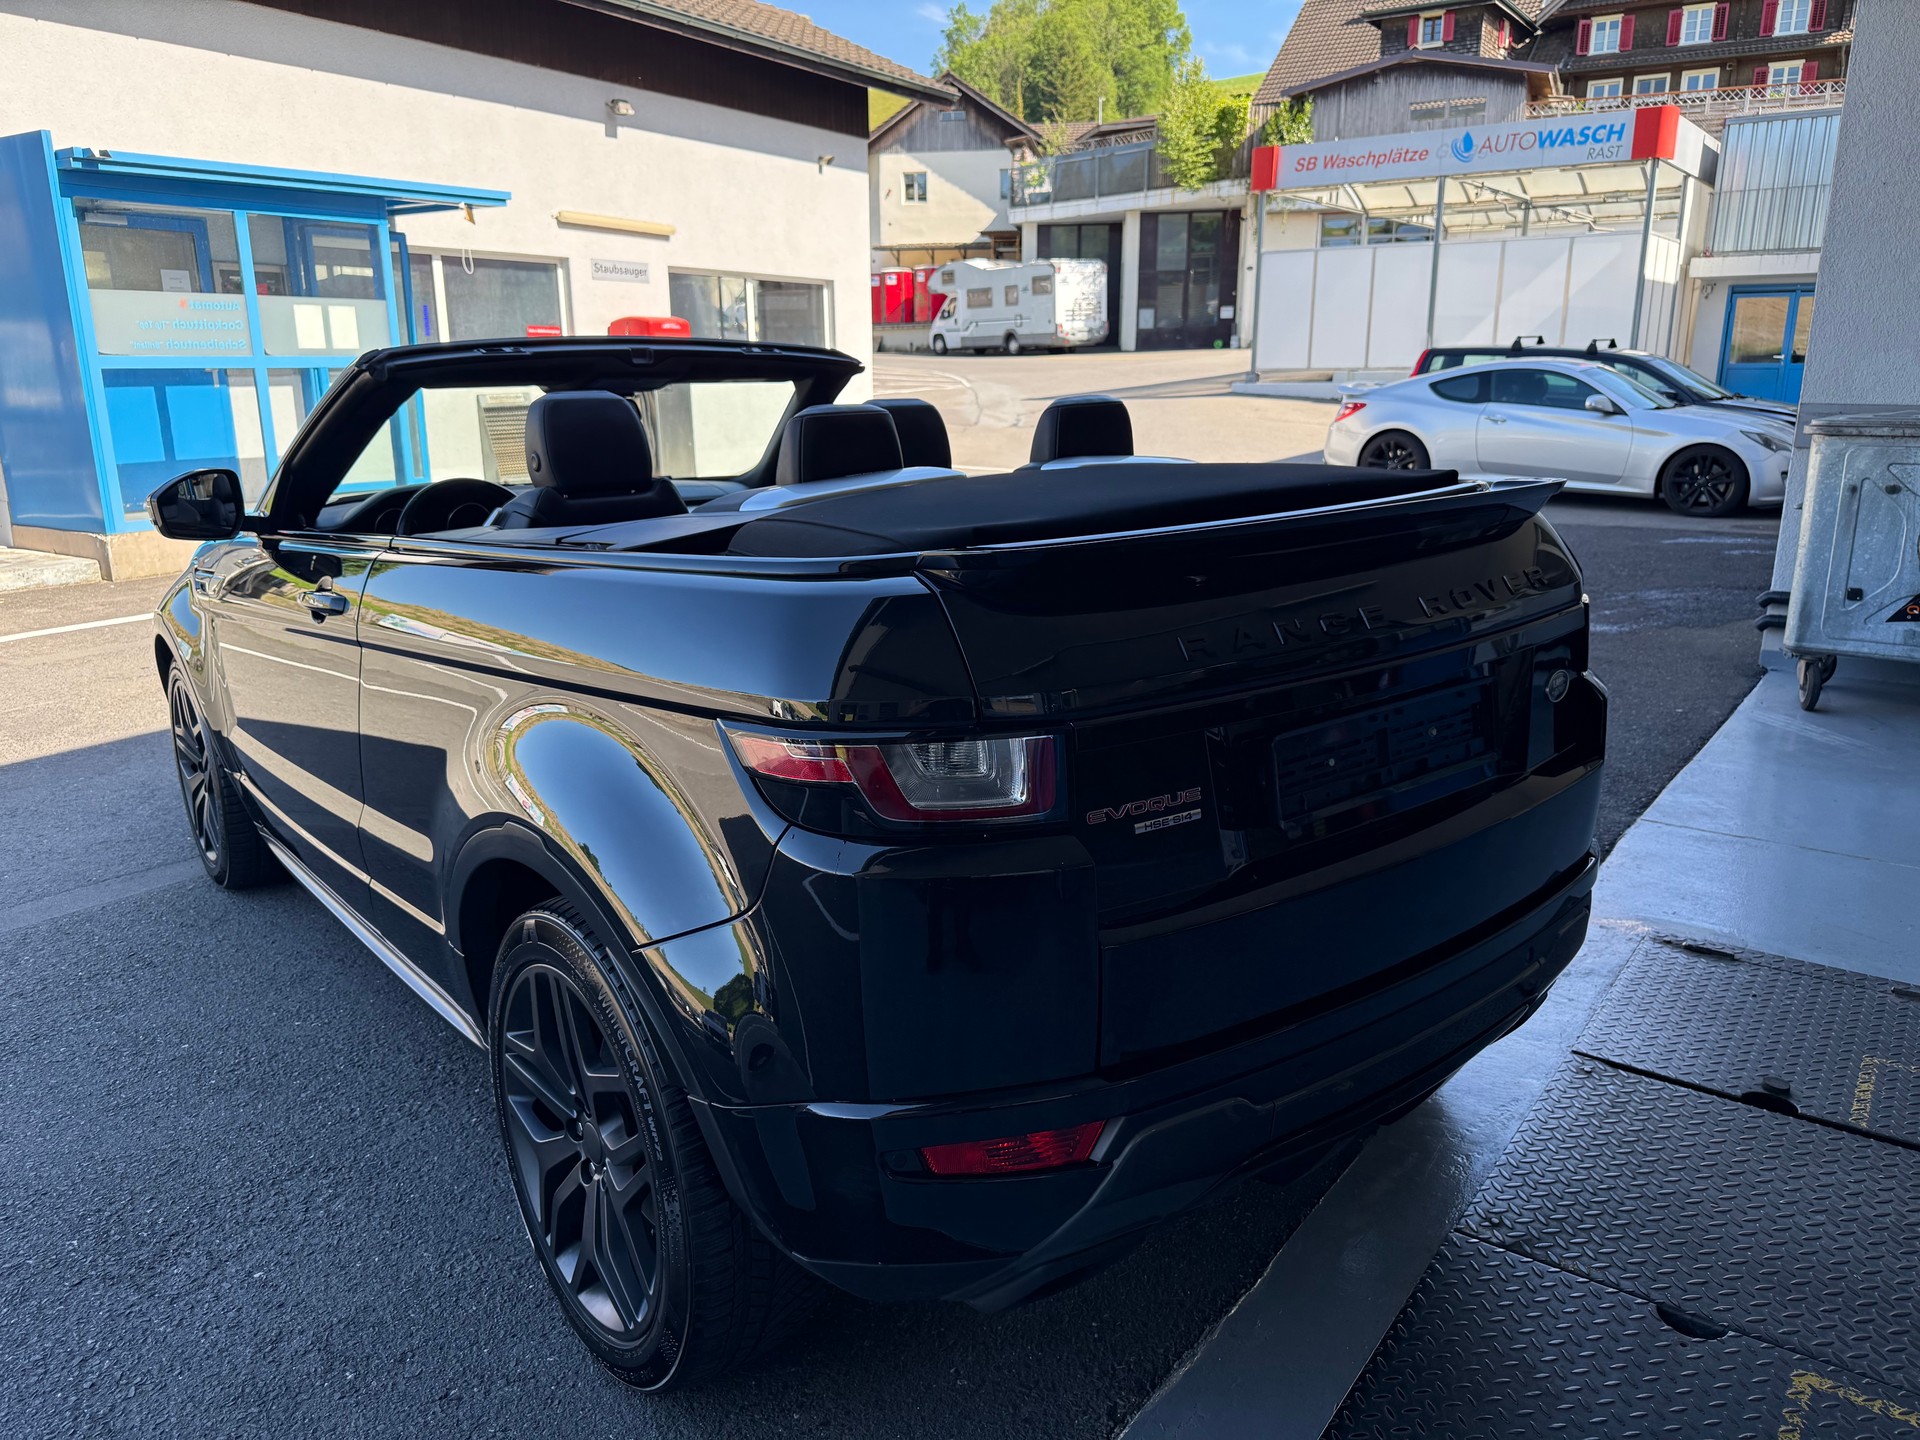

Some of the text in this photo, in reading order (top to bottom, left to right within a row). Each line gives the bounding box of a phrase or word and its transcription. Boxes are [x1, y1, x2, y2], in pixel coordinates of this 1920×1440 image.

[1479, 123, 1626, 154] AUTOWASCH
[1295, 156, 1318, 173] SB
[1323, 147, 1430, 169] Waschplätze
[1586, 145, 1624, 160] RAST
[593, 262, 648, 278] Staubsauger
[1176, 565, 1550, 663] RANGE ROVER
[1086, 787, 1202, 825] EVOQUE
[1144, 819, 1170, 831] HSE
